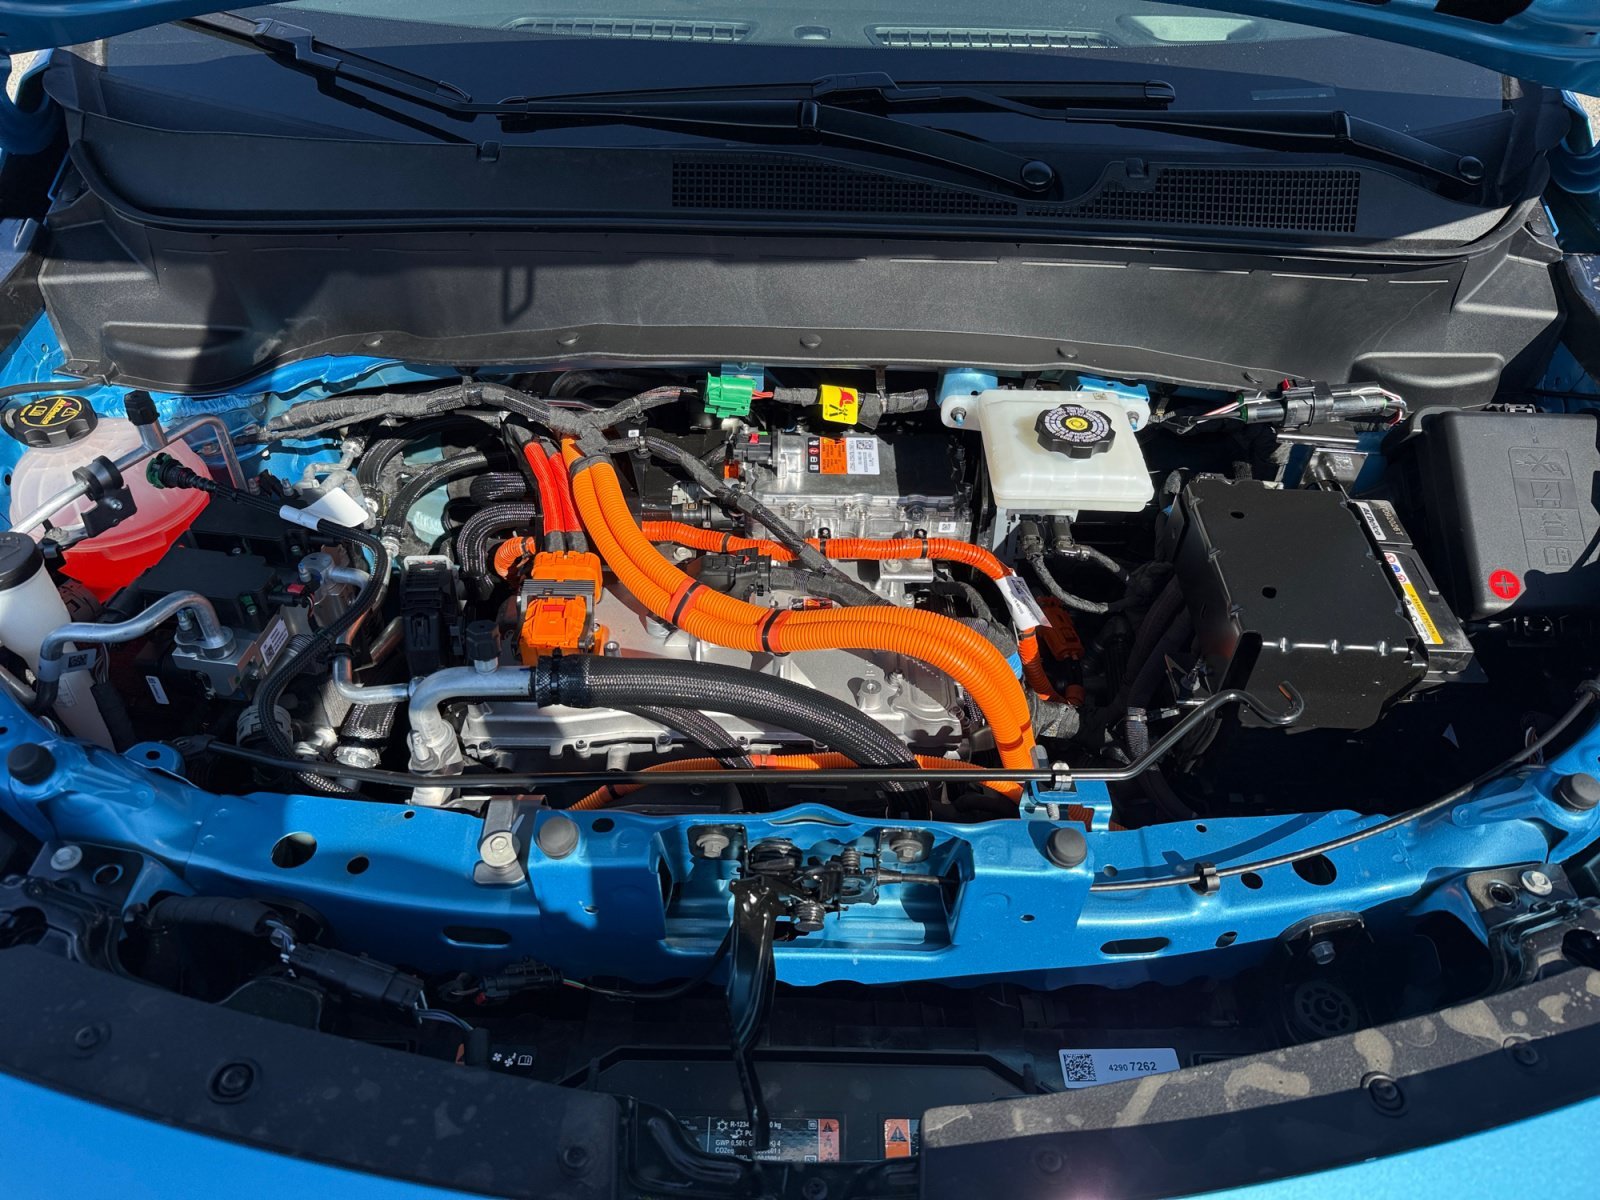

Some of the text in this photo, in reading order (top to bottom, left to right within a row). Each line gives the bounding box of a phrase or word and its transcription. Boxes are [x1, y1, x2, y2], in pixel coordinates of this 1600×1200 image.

[1108, 1061, 1157, 1072] 4290 7262
[730, 1120, 750, 1128] R-1234
[774, 1121, 782, 1130] kg
